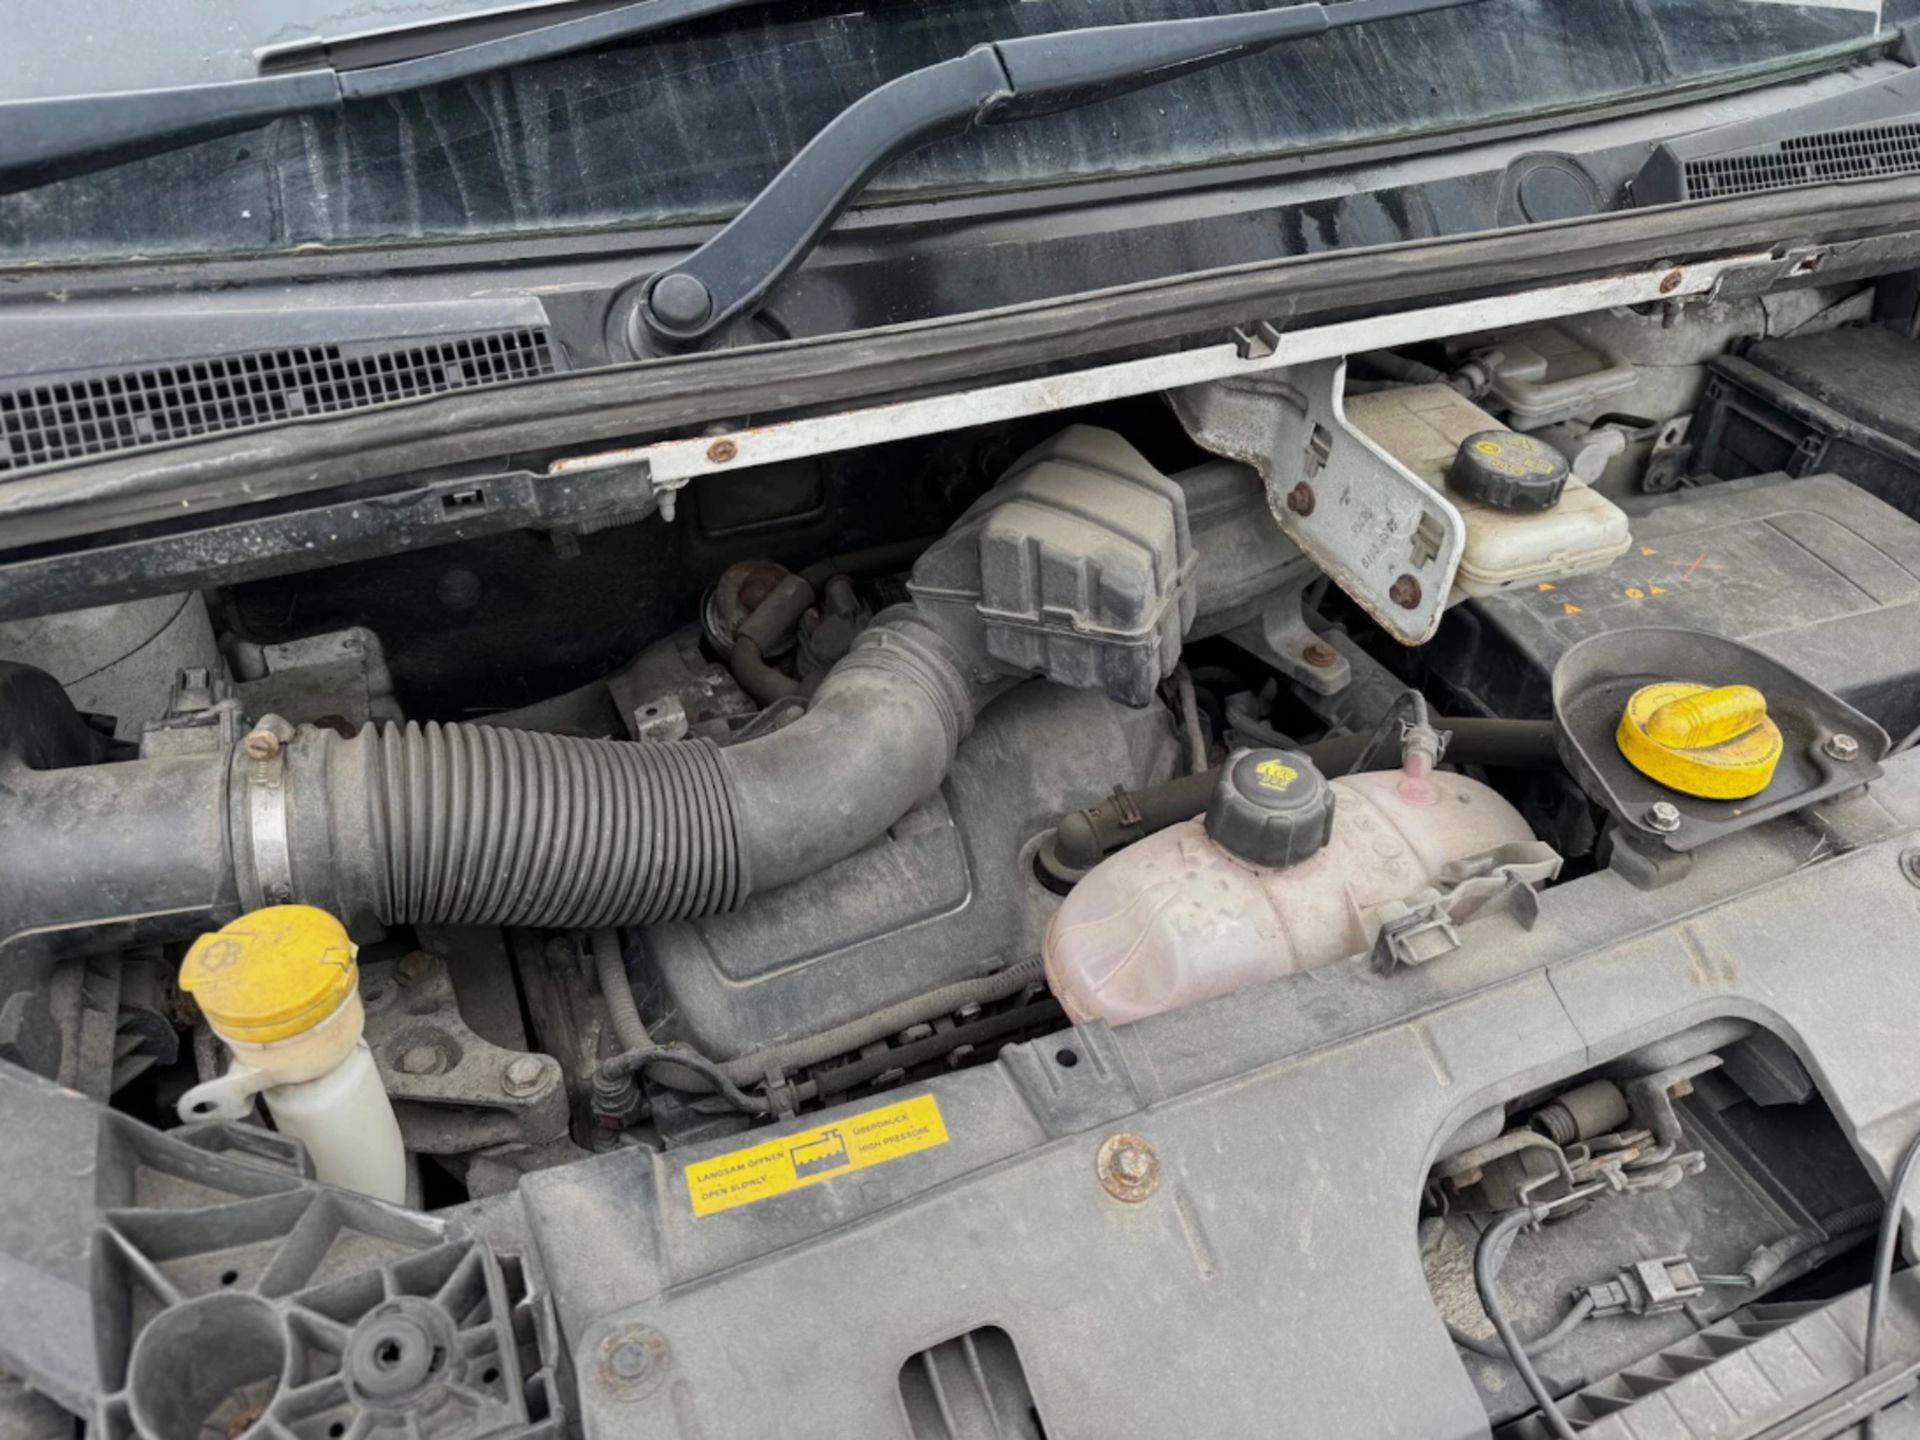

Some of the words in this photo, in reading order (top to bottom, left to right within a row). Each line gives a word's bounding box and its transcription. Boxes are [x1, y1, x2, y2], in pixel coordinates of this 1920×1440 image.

[858, 1140, 881, 1153] HIGH
[883, 1126, 930, 1147] PRESSURE
[697, 1163, 746, 1183] LANGSAM
[701, 1187, 728, 1201] OPEN
[730, 1174, 769, 1194] SLOWLY
